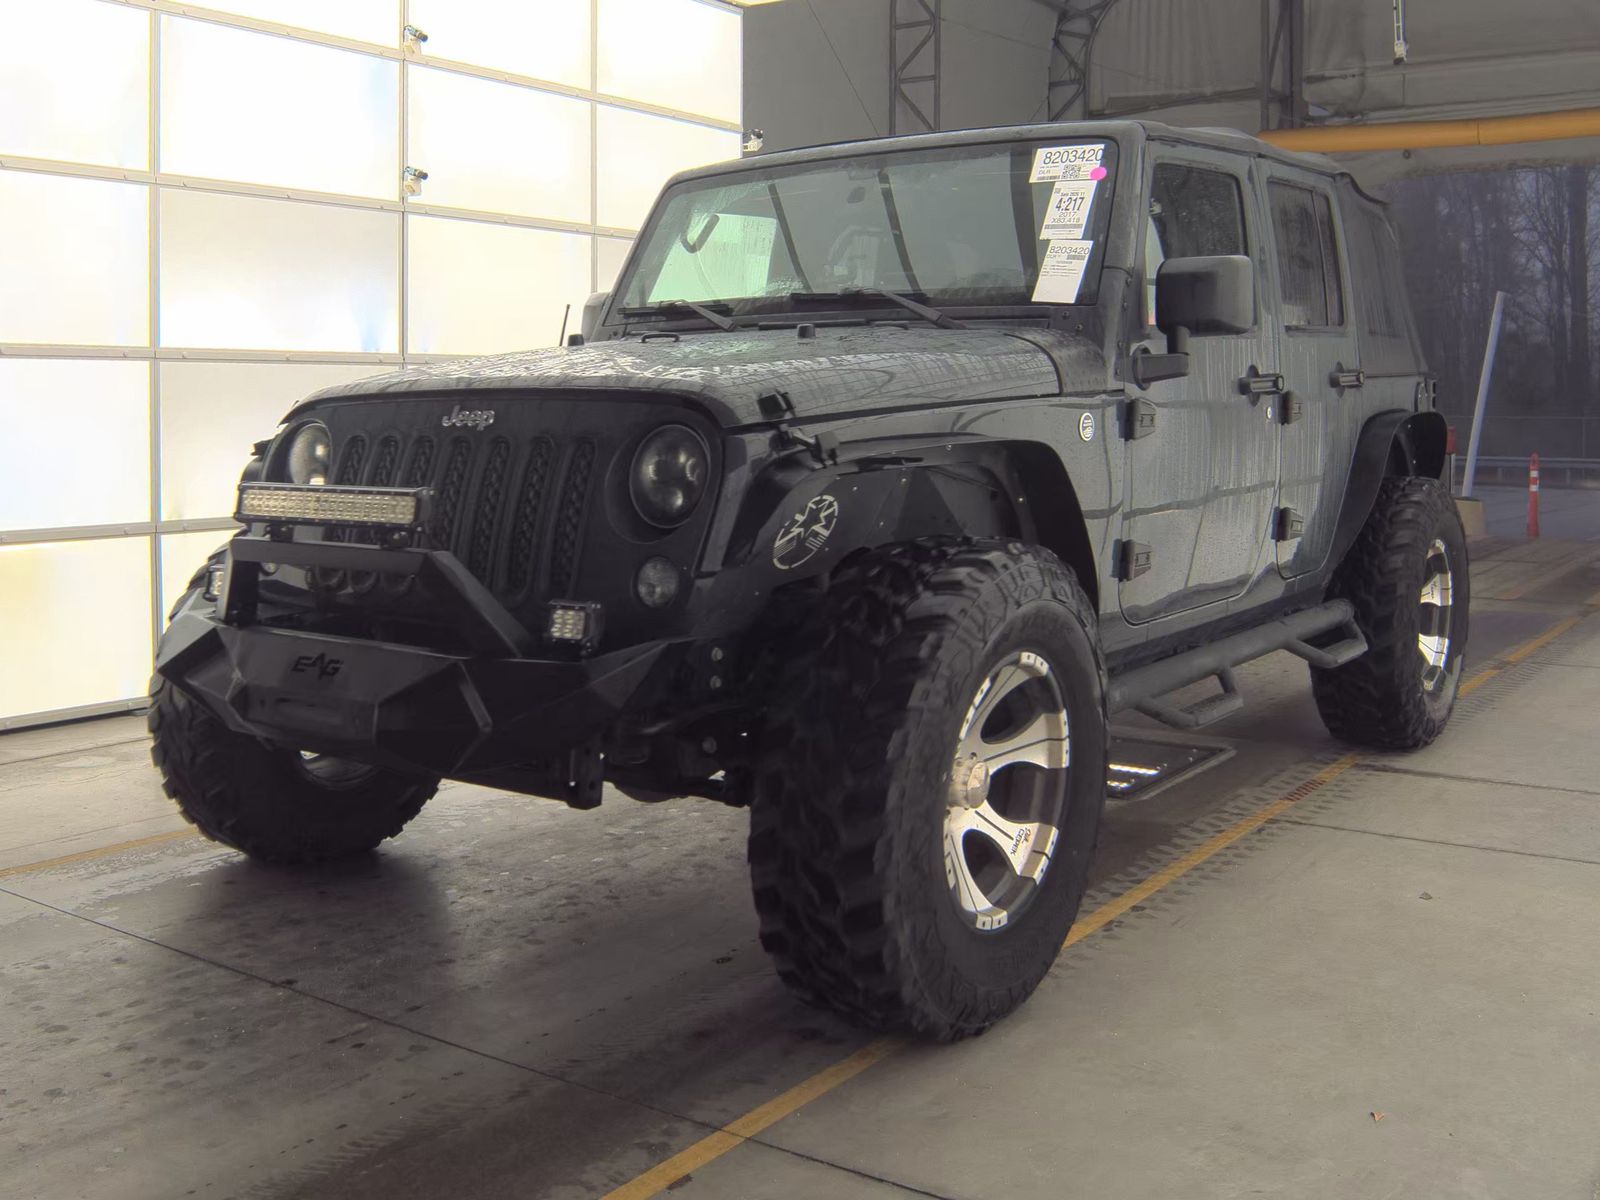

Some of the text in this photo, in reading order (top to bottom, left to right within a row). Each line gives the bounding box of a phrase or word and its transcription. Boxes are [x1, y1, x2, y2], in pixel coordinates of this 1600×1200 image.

[1043, 148, 1104, 165] 8203420
[1055, 196, 1086, 212] 4:217
[1049, 245, 1090, 255] 8203420
[441, 404, 495, 432] Jeep
